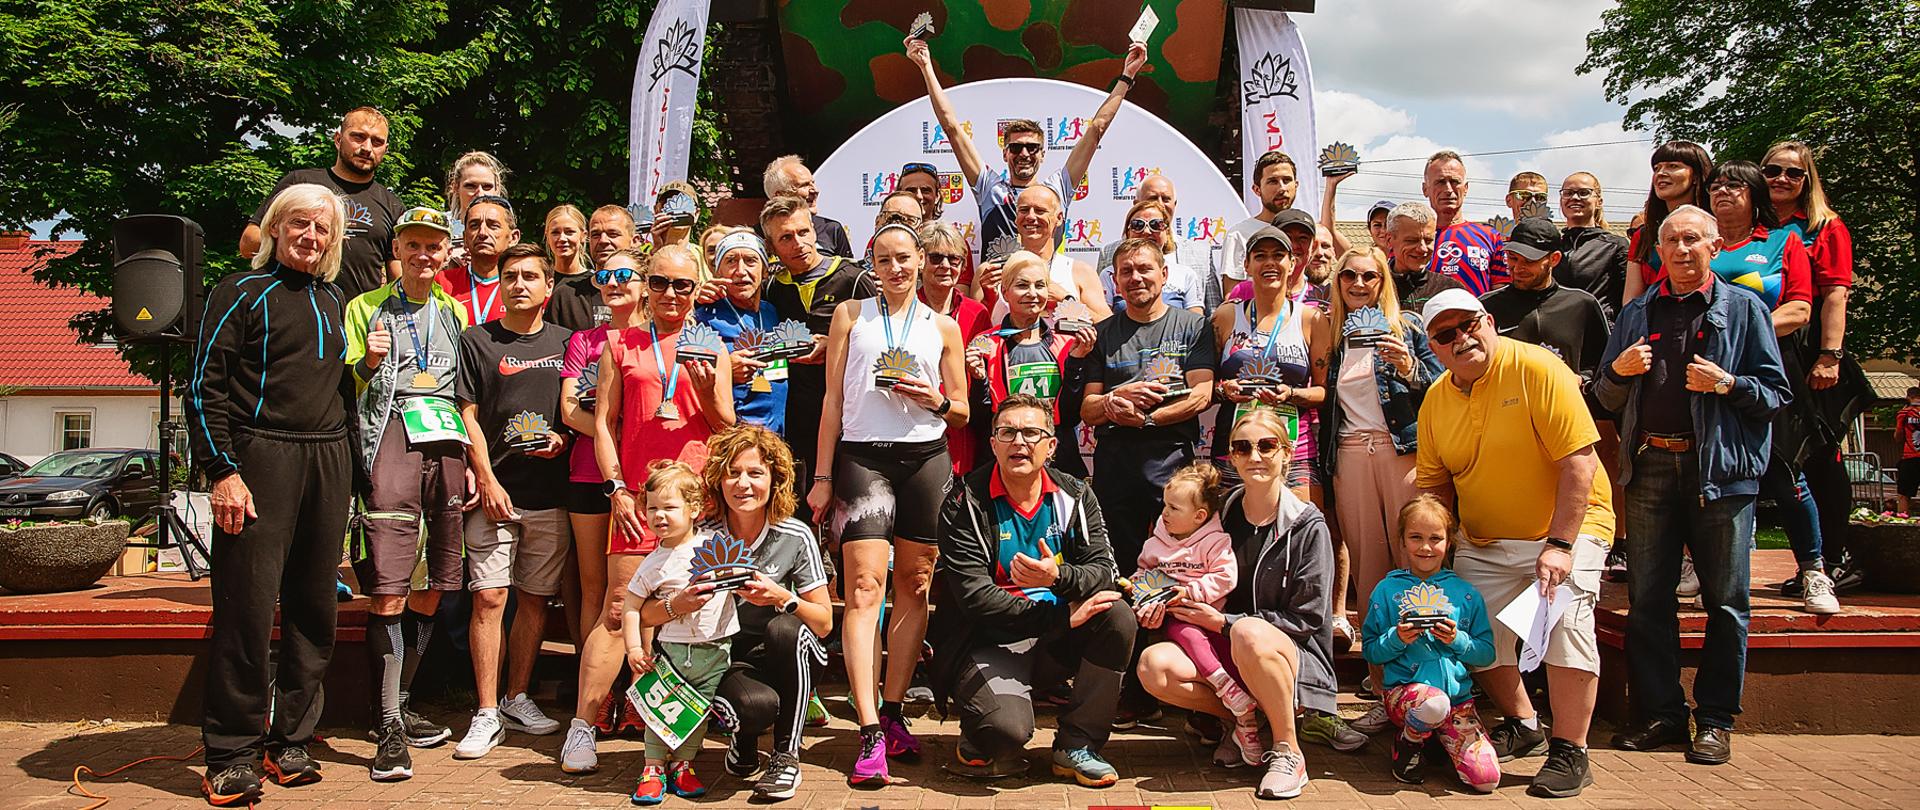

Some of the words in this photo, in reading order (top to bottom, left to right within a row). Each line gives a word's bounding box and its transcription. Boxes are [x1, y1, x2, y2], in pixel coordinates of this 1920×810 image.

[507, 356, 564, 371] Running
[1019, 376, 1049, 397] 41
[645, 680, 686, 725] 54
